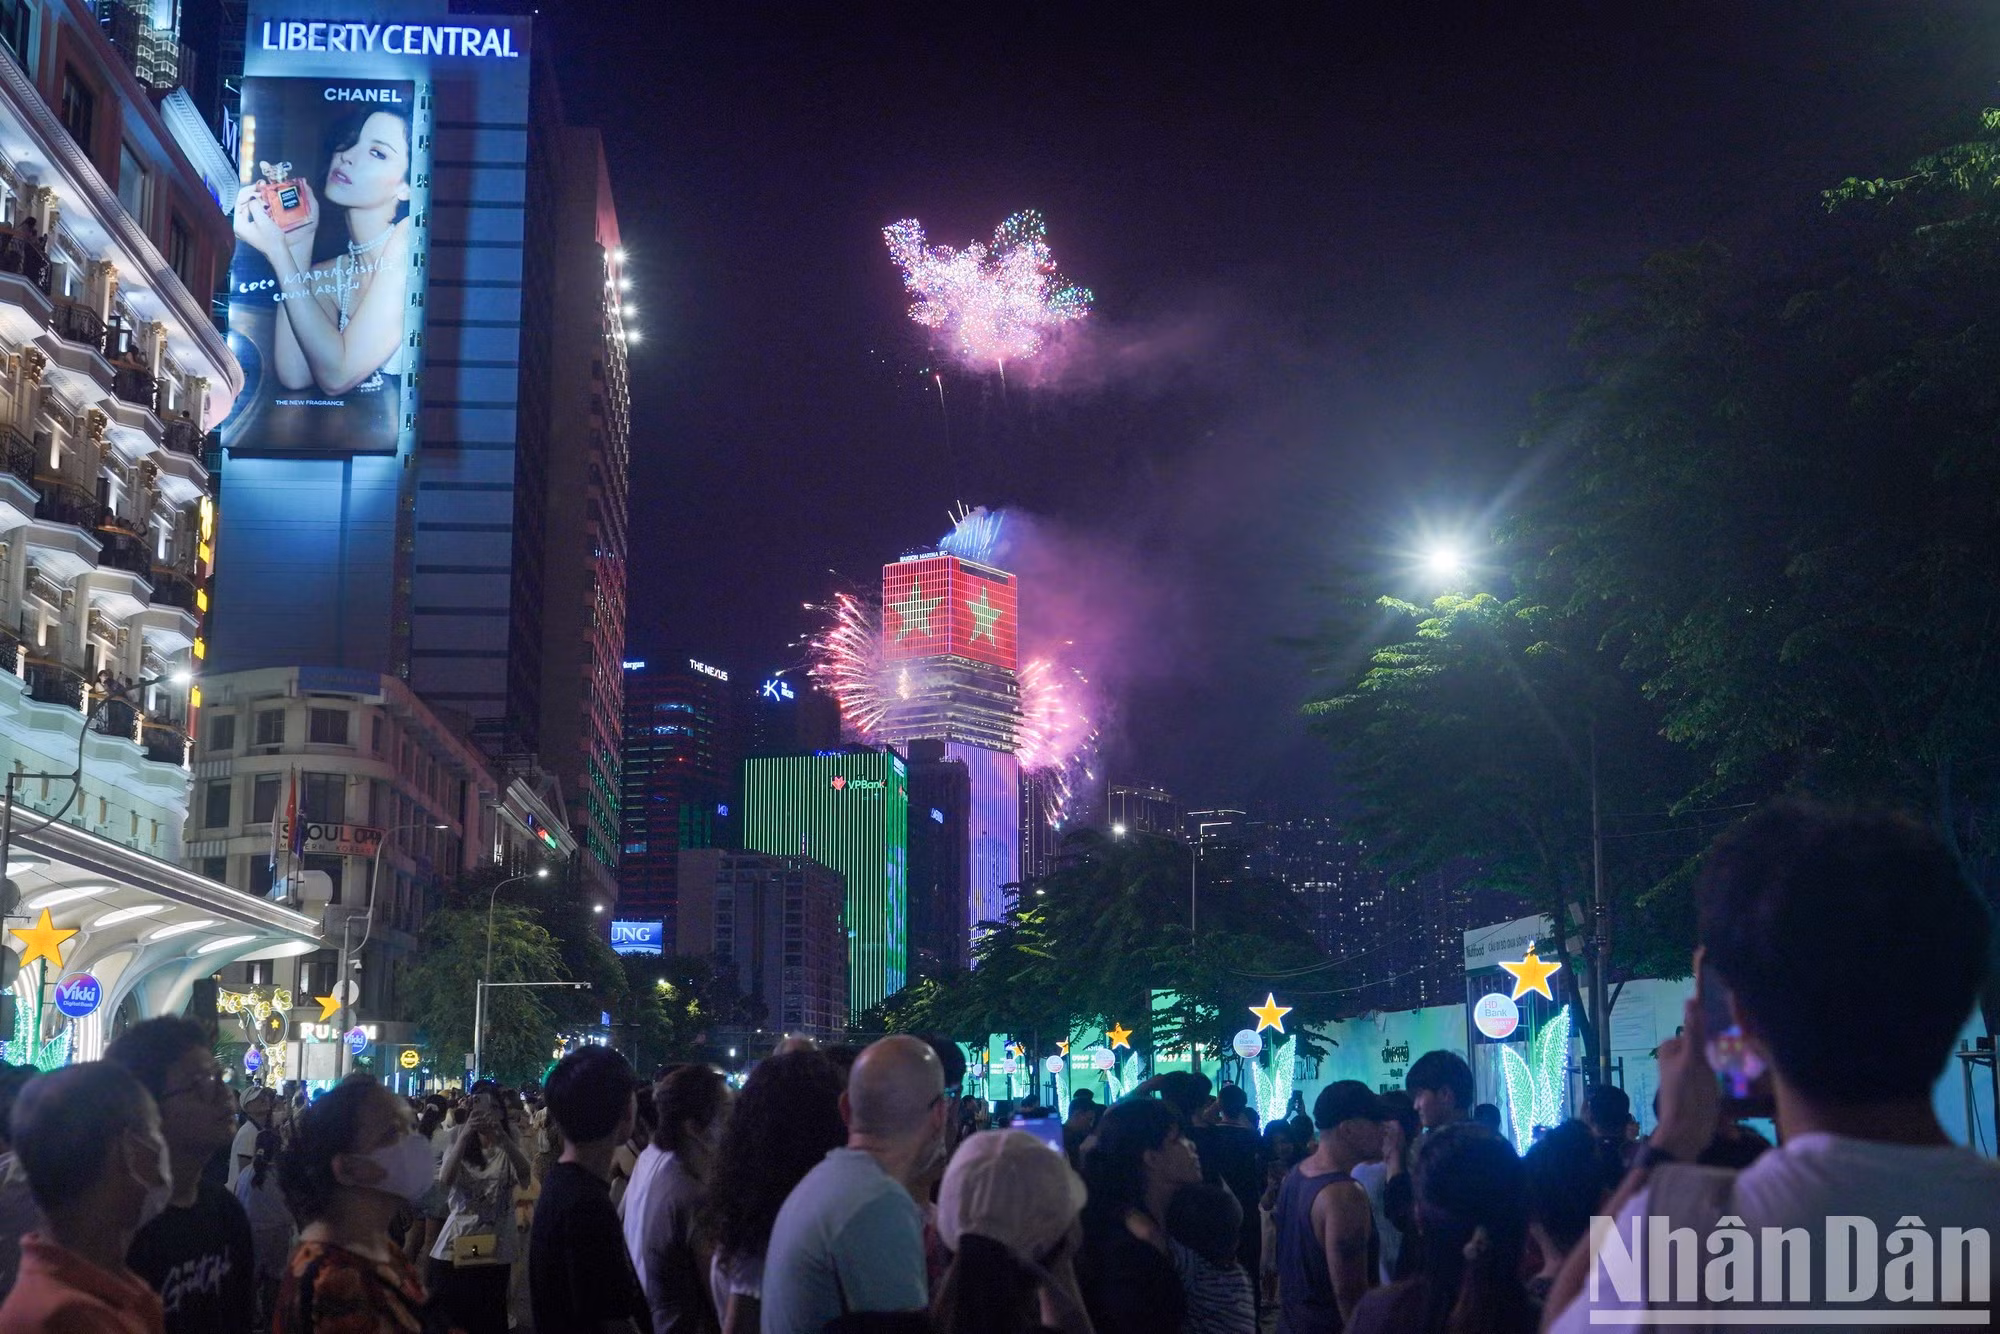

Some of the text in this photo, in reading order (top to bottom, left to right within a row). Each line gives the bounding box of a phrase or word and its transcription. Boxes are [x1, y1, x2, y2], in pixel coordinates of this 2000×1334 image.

[262, 22, 518, 57] LIBERTY CENTRAL
[324, 87, 402, 103] CHANEL
[239, 279, 275, 294] COCO
[689, 658, 728, 681] THE NEXUS
[848, 779, 886, 790] VPBank
[60, 979, 96, 1002] Vikki
[1484, 1001, 1497, 1009] HD
[1485, 1009, 1507, 1017] Bank
